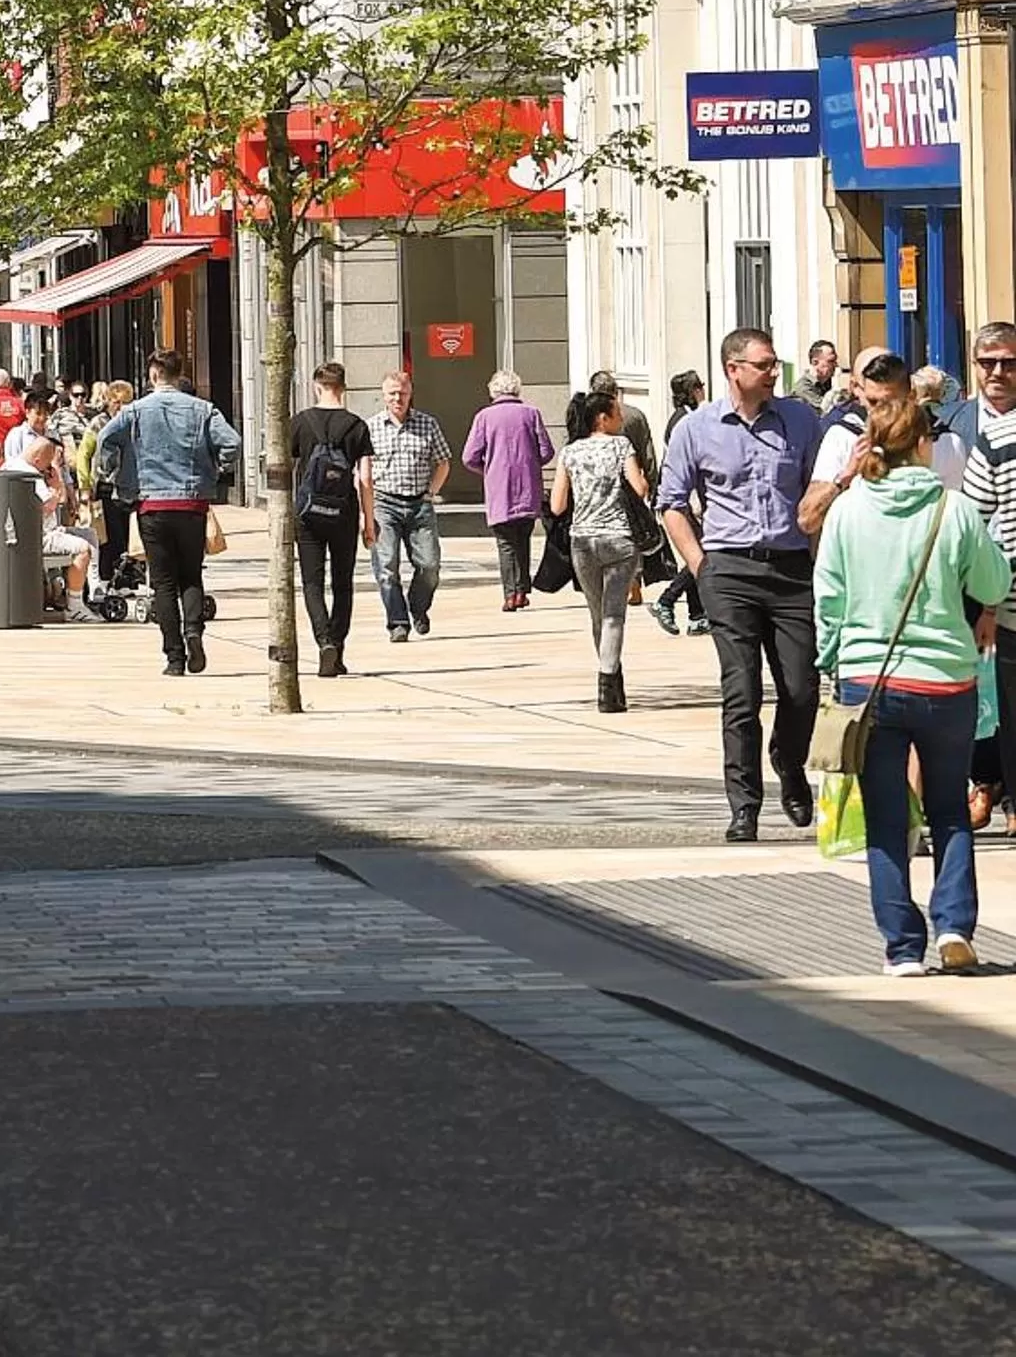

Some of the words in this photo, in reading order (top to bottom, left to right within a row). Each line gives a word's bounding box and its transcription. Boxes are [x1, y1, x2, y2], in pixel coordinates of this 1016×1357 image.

[357, 3, 380, 15] FOX
[696, 98, 811, 122] BETFRED
[859, 55, 960, 149] BETFRED
[696, 126, 724, 137] THE
[726, 124, 774, 136] BONUS
[776, 122, 811, 134] KING
